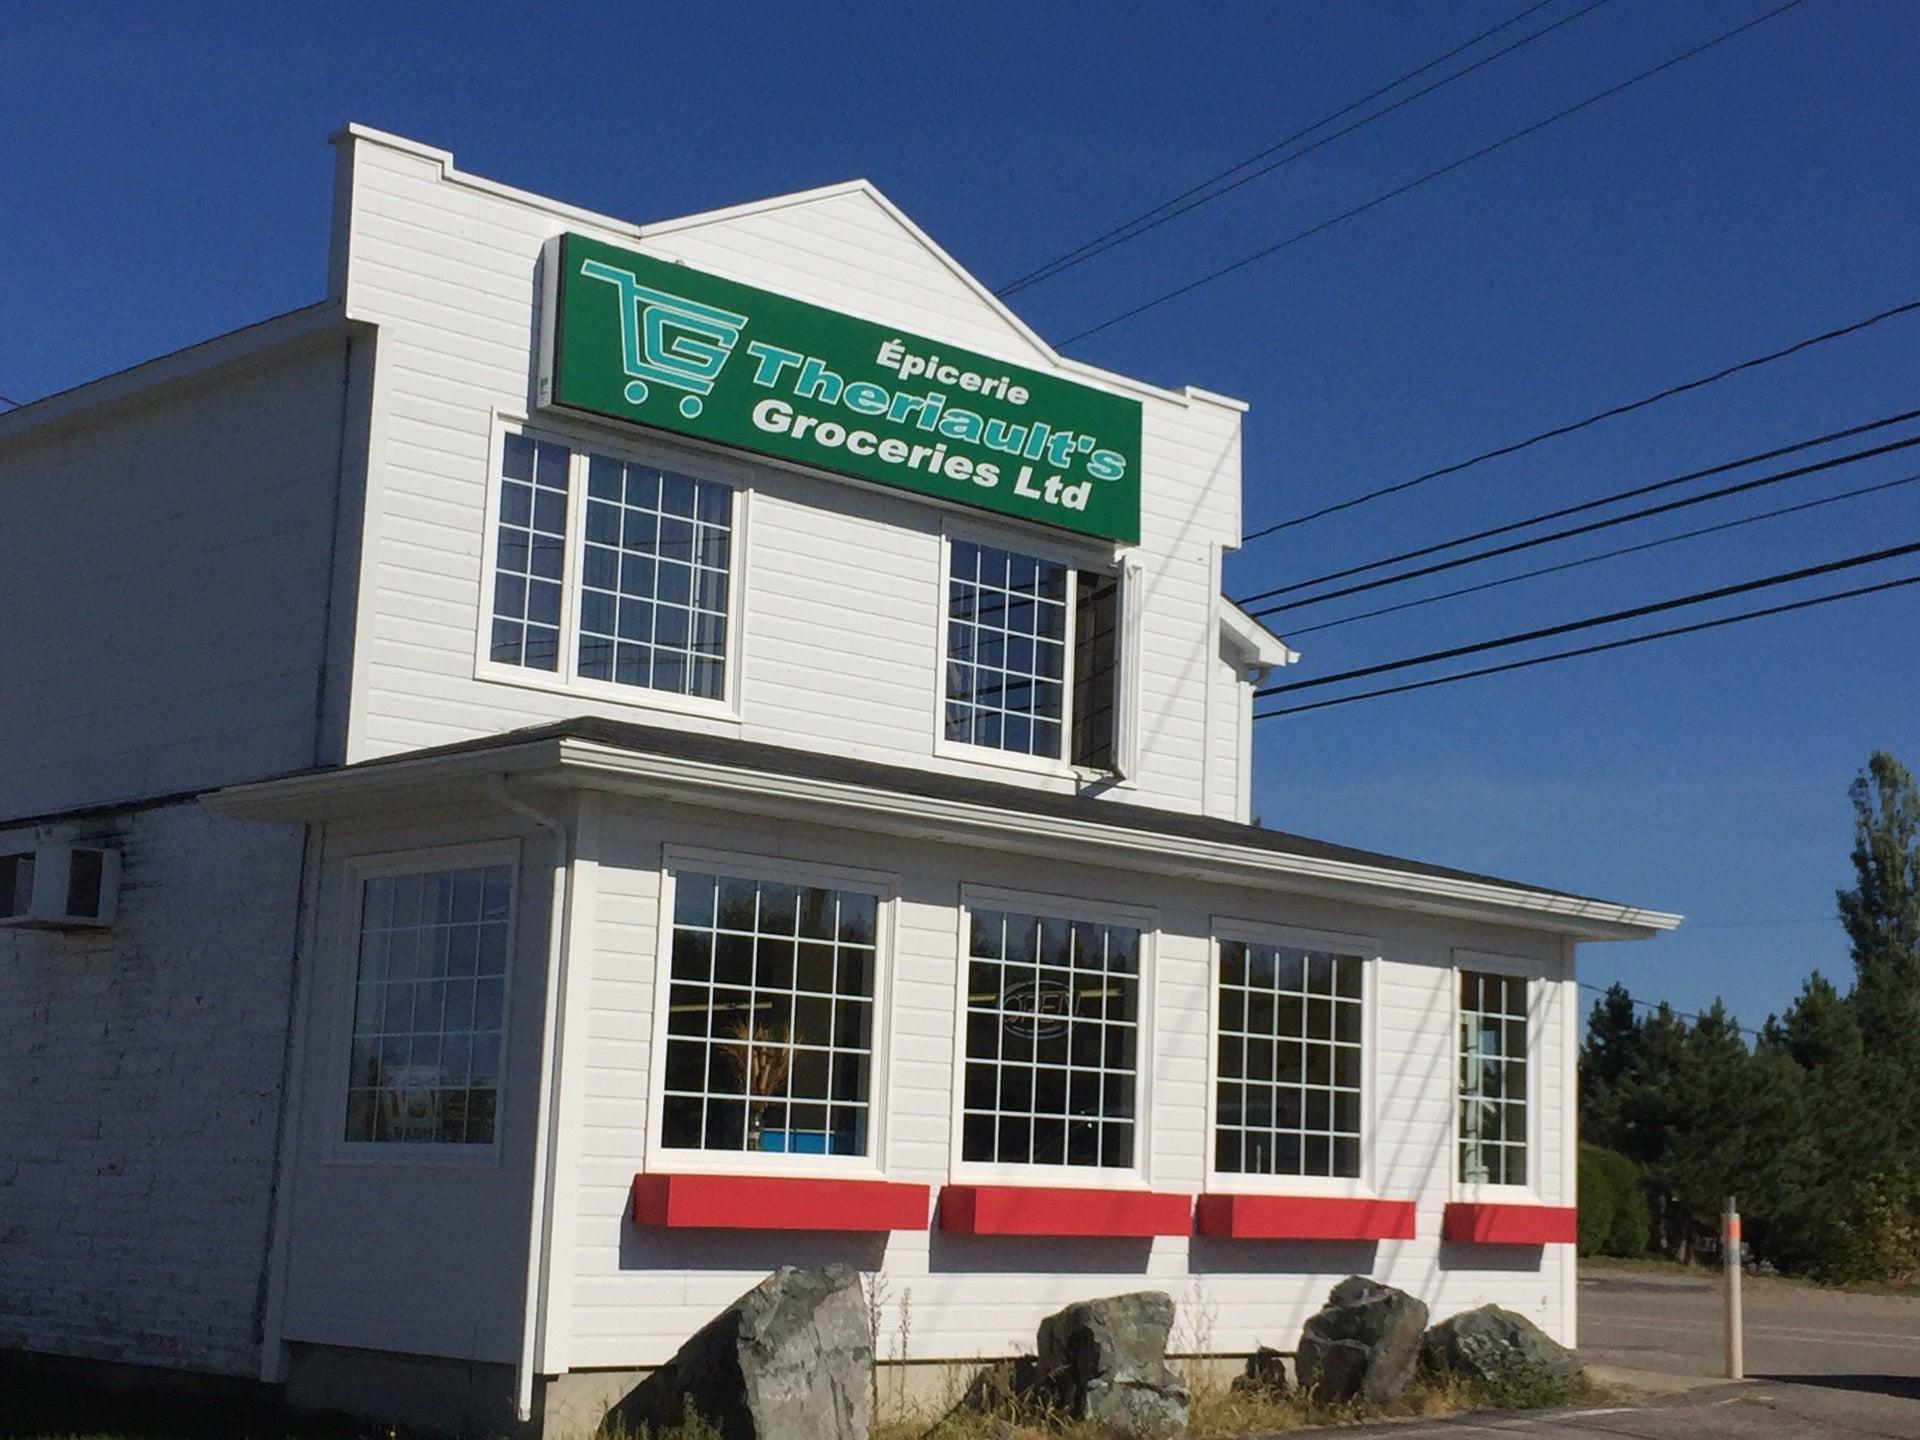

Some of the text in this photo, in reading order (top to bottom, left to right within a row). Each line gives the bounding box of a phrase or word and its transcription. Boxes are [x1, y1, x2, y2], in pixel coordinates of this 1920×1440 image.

[746, 341, 1127, 482] Theriault's
[876, 338, 1030, 406] Épicerie
[752, 398, 1092, 512] Groceries Ltd
